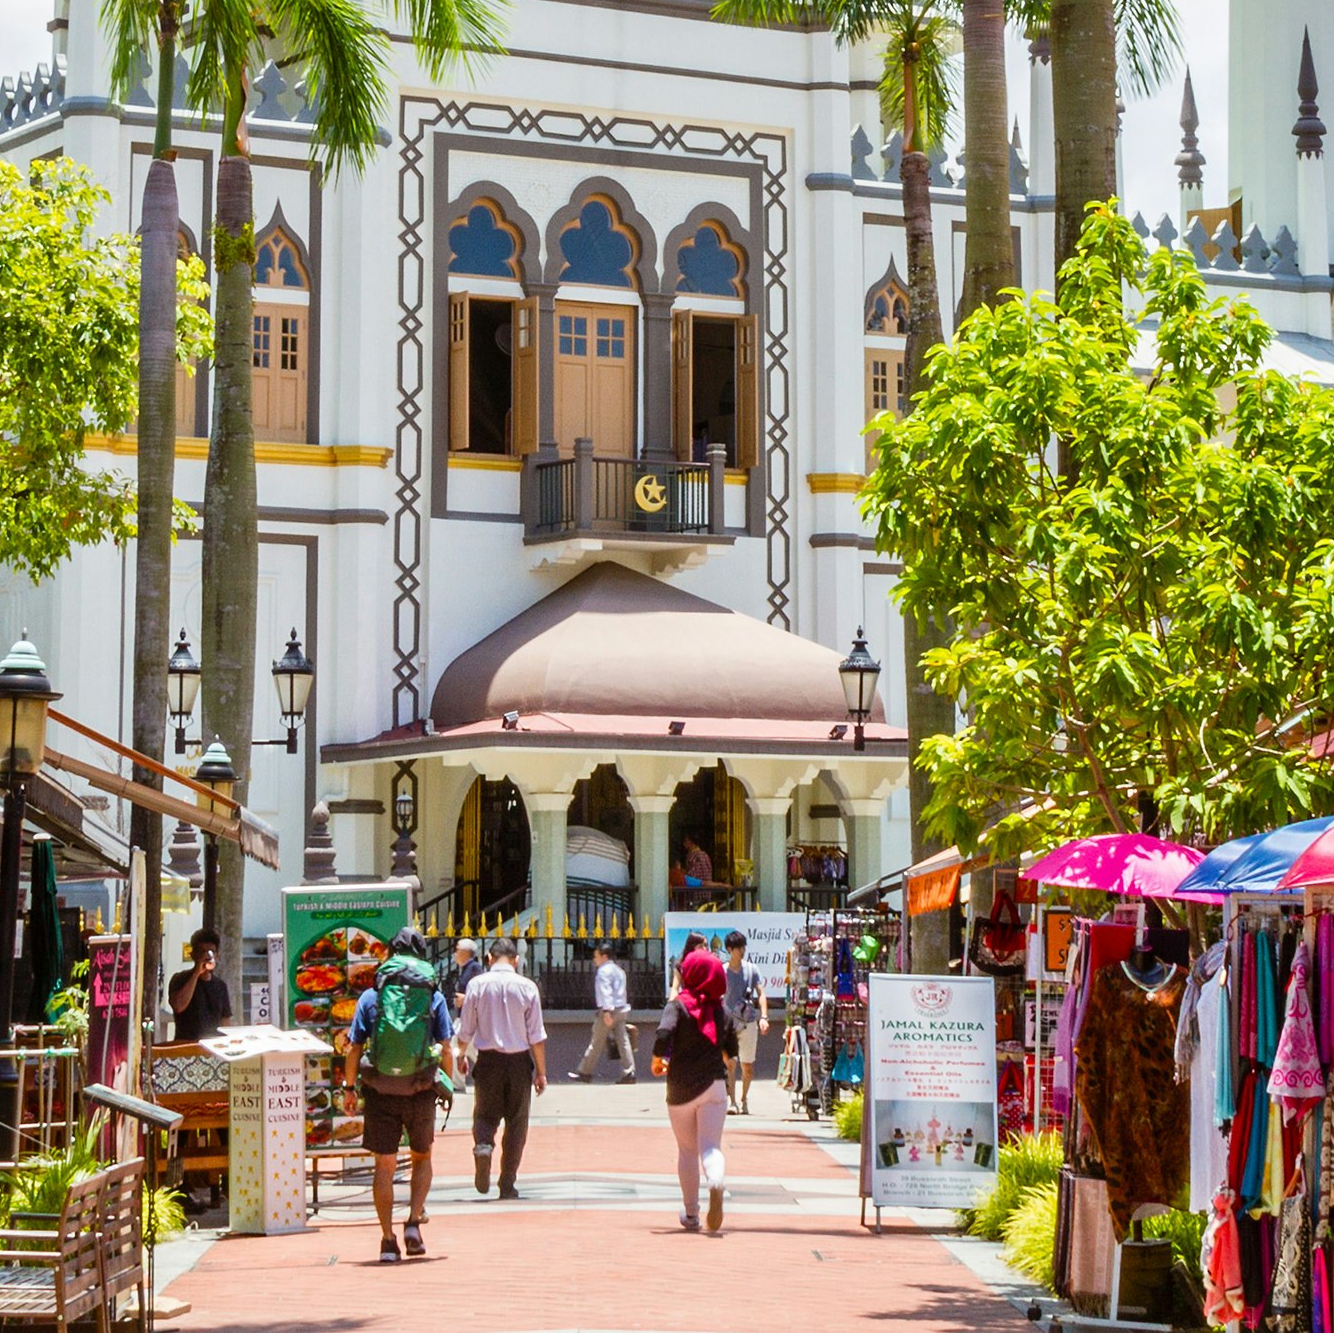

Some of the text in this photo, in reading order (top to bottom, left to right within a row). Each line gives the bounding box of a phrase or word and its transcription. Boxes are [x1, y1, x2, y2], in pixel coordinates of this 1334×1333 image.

[293, 902, 318, 911] Turkish
[325, 901, 347, 909] Middle
[349, 901, 374, 909] Eastern
[375, 900, 400, 908] Cuisine
[747, 928, 781, 943] Masjid
[747, 952, 769, 965] Kini
[881, 1019, 985, 1031] JAMAL KAZURA
[893, 1032, 973, 1043] AROMATICS
[233, 1067, 260, 1075] TURKISH
[268, 1068, 301, 1076] TURKISH
[233, 1083, 260, 1092] MIDDLE
[268, 1084, 300, 1093] MIDDLE
[233, 1096, 261, 1108] EAST
[269, 1096, 301, 1109] EAST
[267, 1114, 299, 1123] CUISINE
